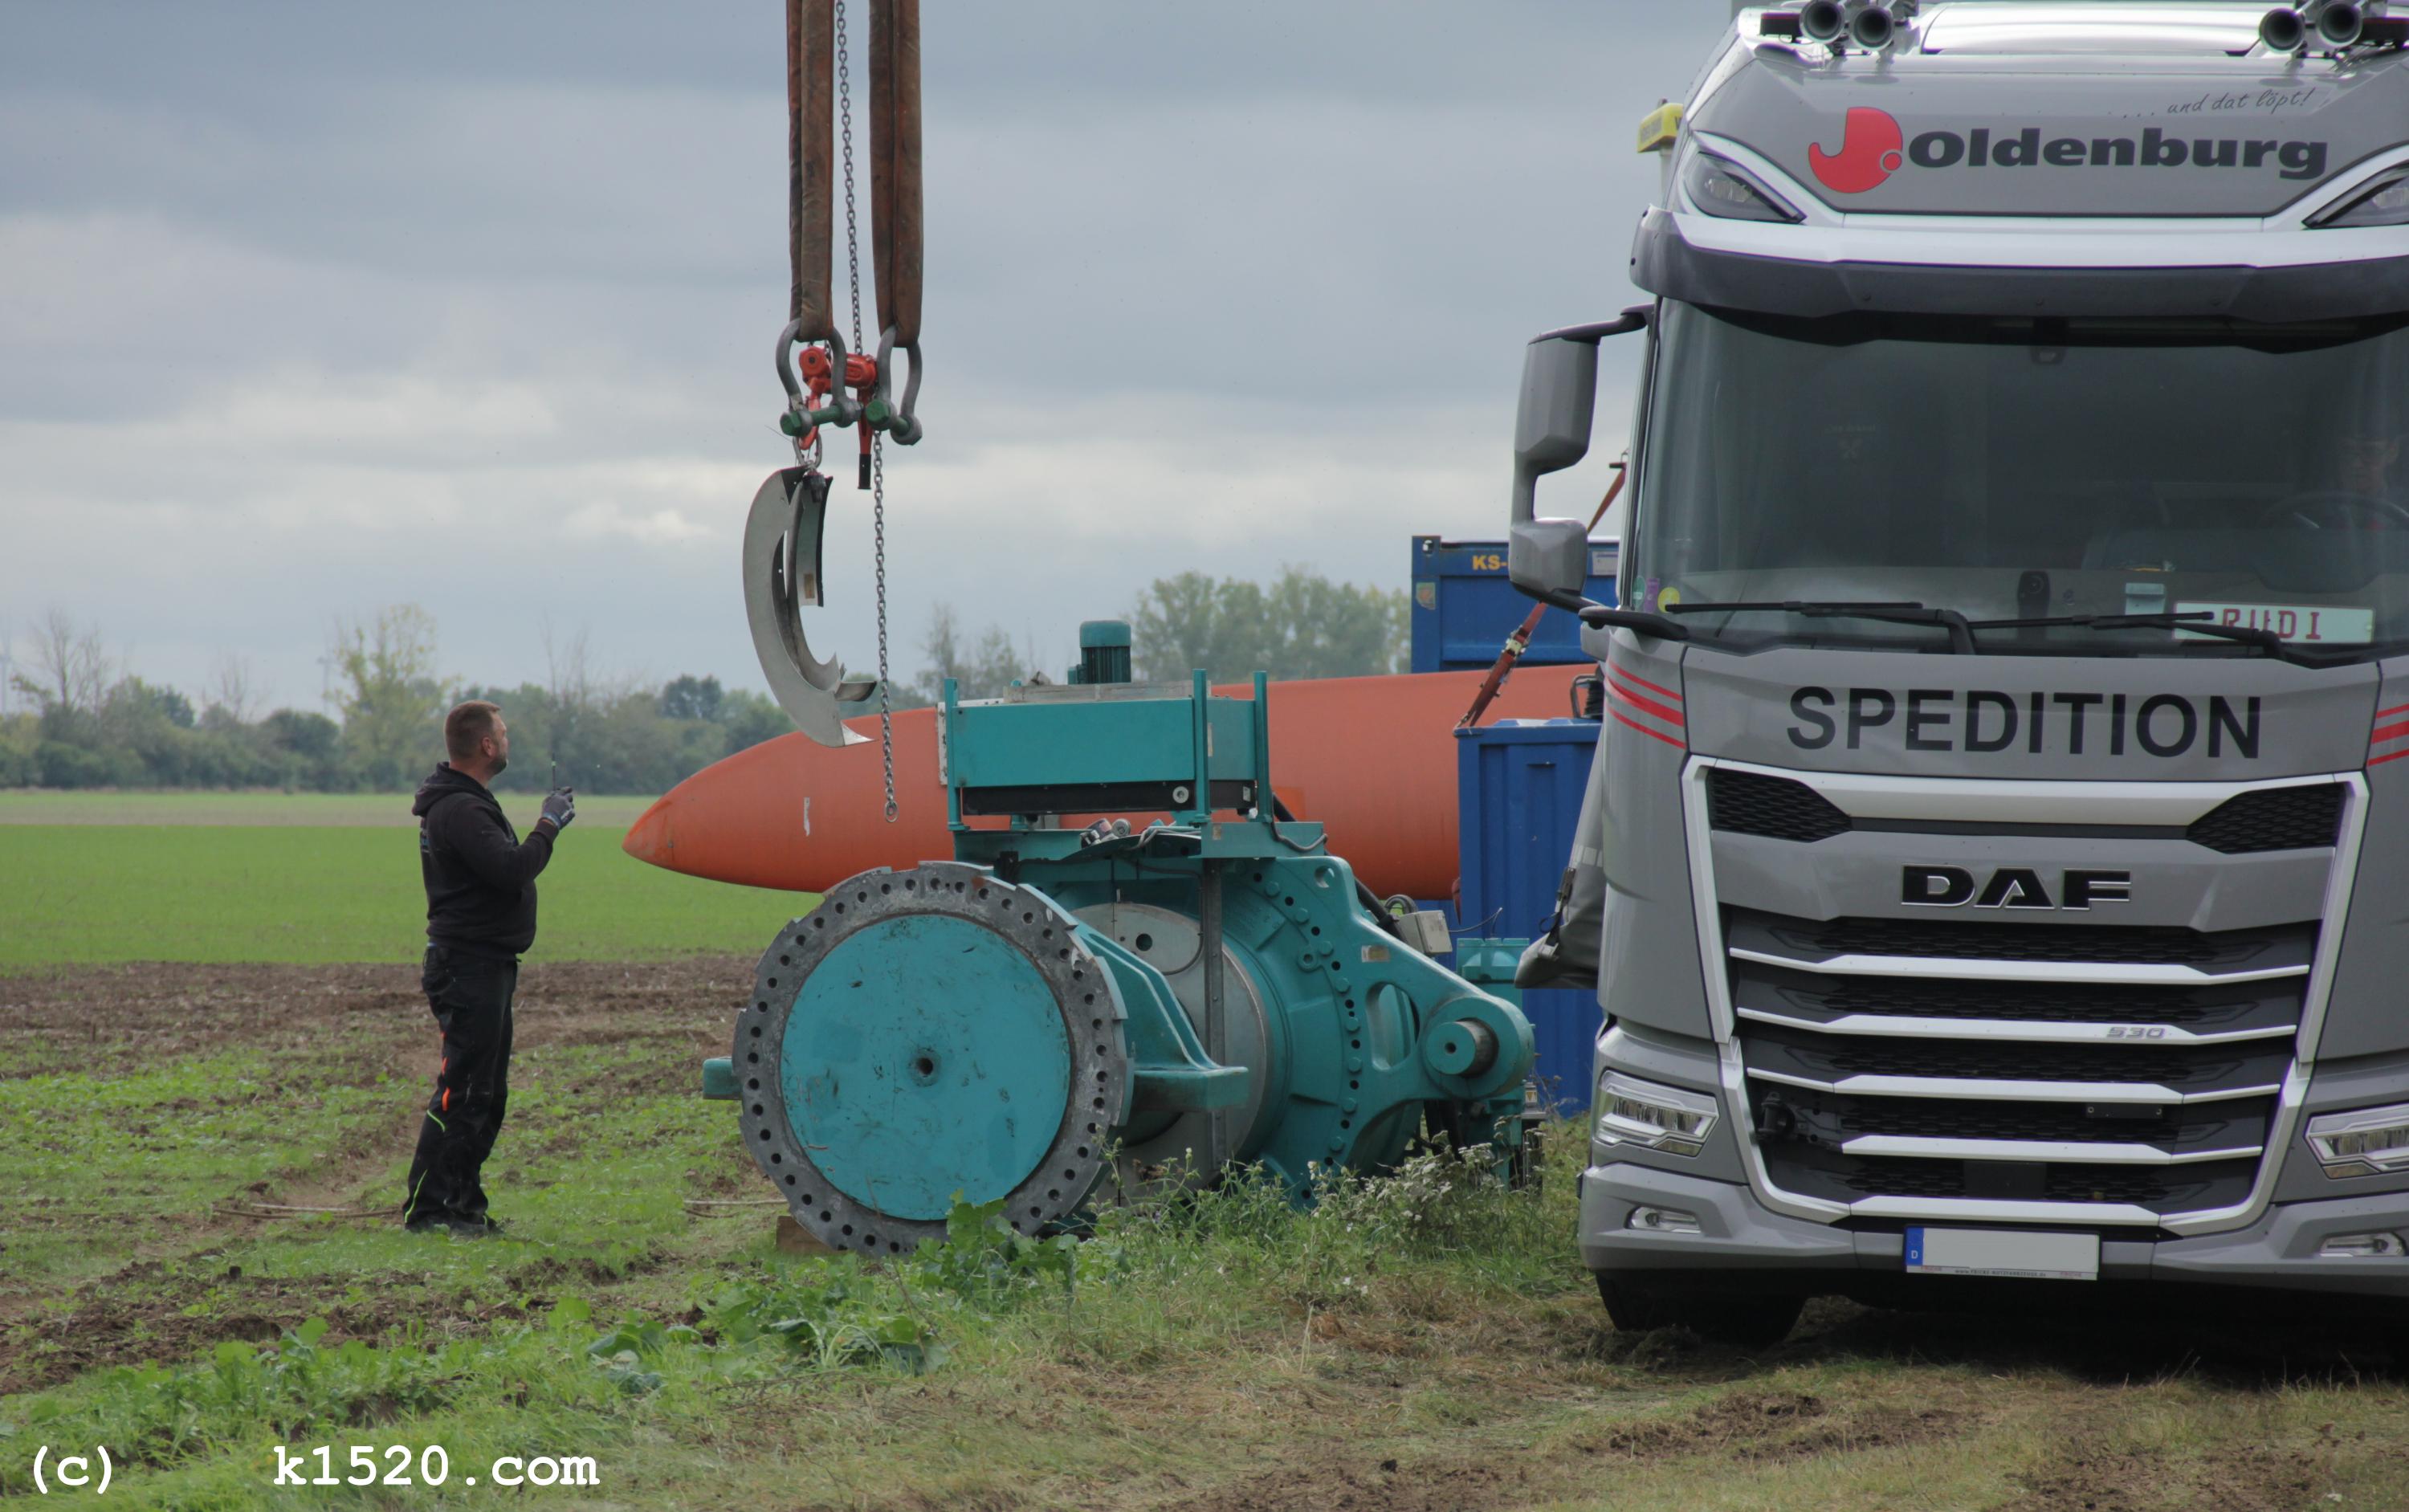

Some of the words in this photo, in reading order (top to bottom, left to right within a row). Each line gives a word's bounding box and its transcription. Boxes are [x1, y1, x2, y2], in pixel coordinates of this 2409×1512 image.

[2211, 92, 2250, 111] dat
[1908, 128, 2327, 180] Oldenburg
[2222, 608, 2321, 640] RUDI
[1787, 686, 2261, 759] SPEDITION
[1902, 863, 2132, 911] DAF
[2106, 1027, 2166, 1039] 530
[1911, 1249, 1918, 1259] D
